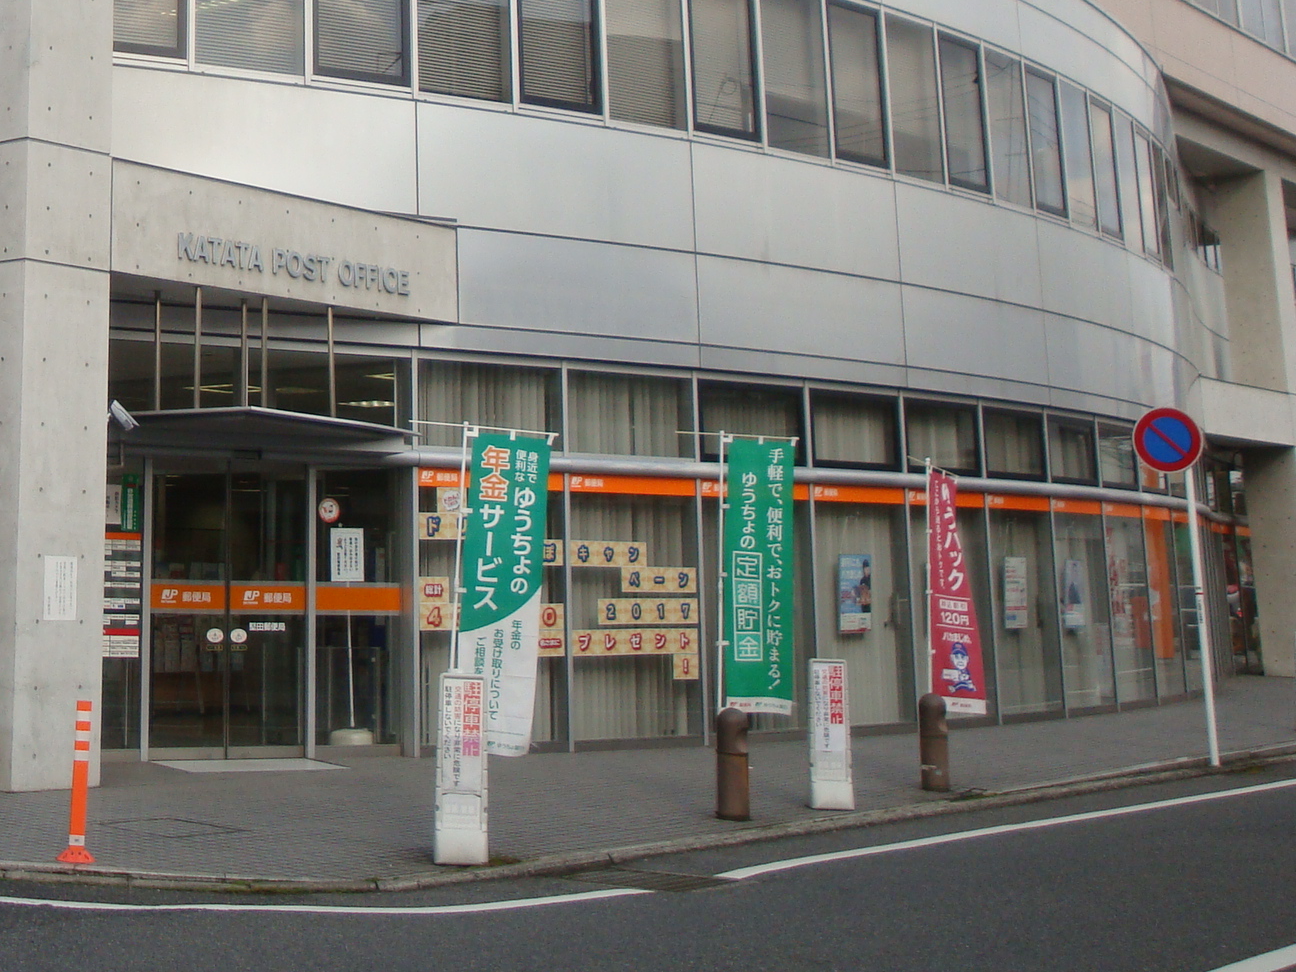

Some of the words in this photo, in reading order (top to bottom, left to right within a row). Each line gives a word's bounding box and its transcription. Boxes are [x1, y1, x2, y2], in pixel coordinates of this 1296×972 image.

[177, 231, 264, 273] KATATA
[272, 248, 331, 283] POST
[338, 259, 411, 297] OFFICE
[514, 449, 528, 482] 便利な
[527, 451, 539, 484] 身近で
[740, 471, 757, 549] ゆうちょの
[473, 445, 511, 611] 年金サービス
[510, 486, 536, 595] ゆうちょの
[182, 591, 211, 603] 郵便局
[263, 592, 292, 604] 郵便局
[606, 602, 691, 621] 2017
[736, 556, 758, 657] 定額貯金
[510, 620, 522, 650] 年金の
[940, 611, 969, 626] 120円
[578, 632, 690, 651] プレゼント
[489, 628, 504, 720] お受け取りについて
[462, 681, 481, 756] 駐停車禁止
